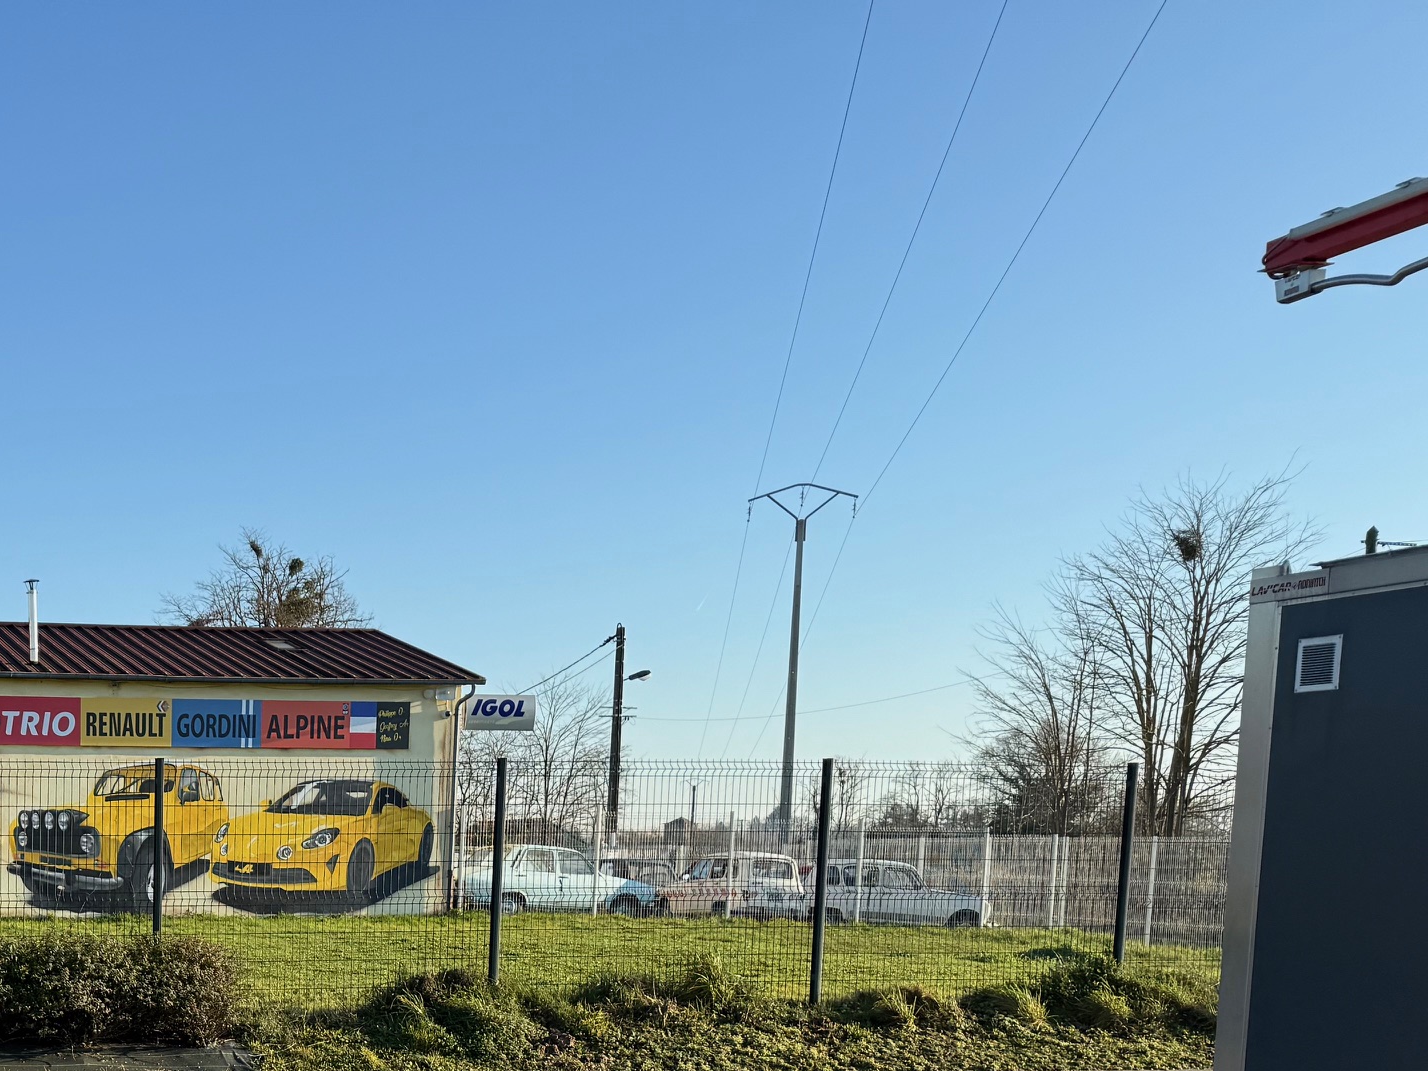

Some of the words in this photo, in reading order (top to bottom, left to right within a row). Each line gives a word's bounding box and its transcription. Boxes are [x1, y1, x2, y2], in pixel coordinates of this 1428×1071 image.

[471, 698, 526, 717] IGOL
[85, 712, 167, 737] RENAULT
[176, 713, 257, 739] GORDINI
[266, 714, 346, 740] ALPINE
